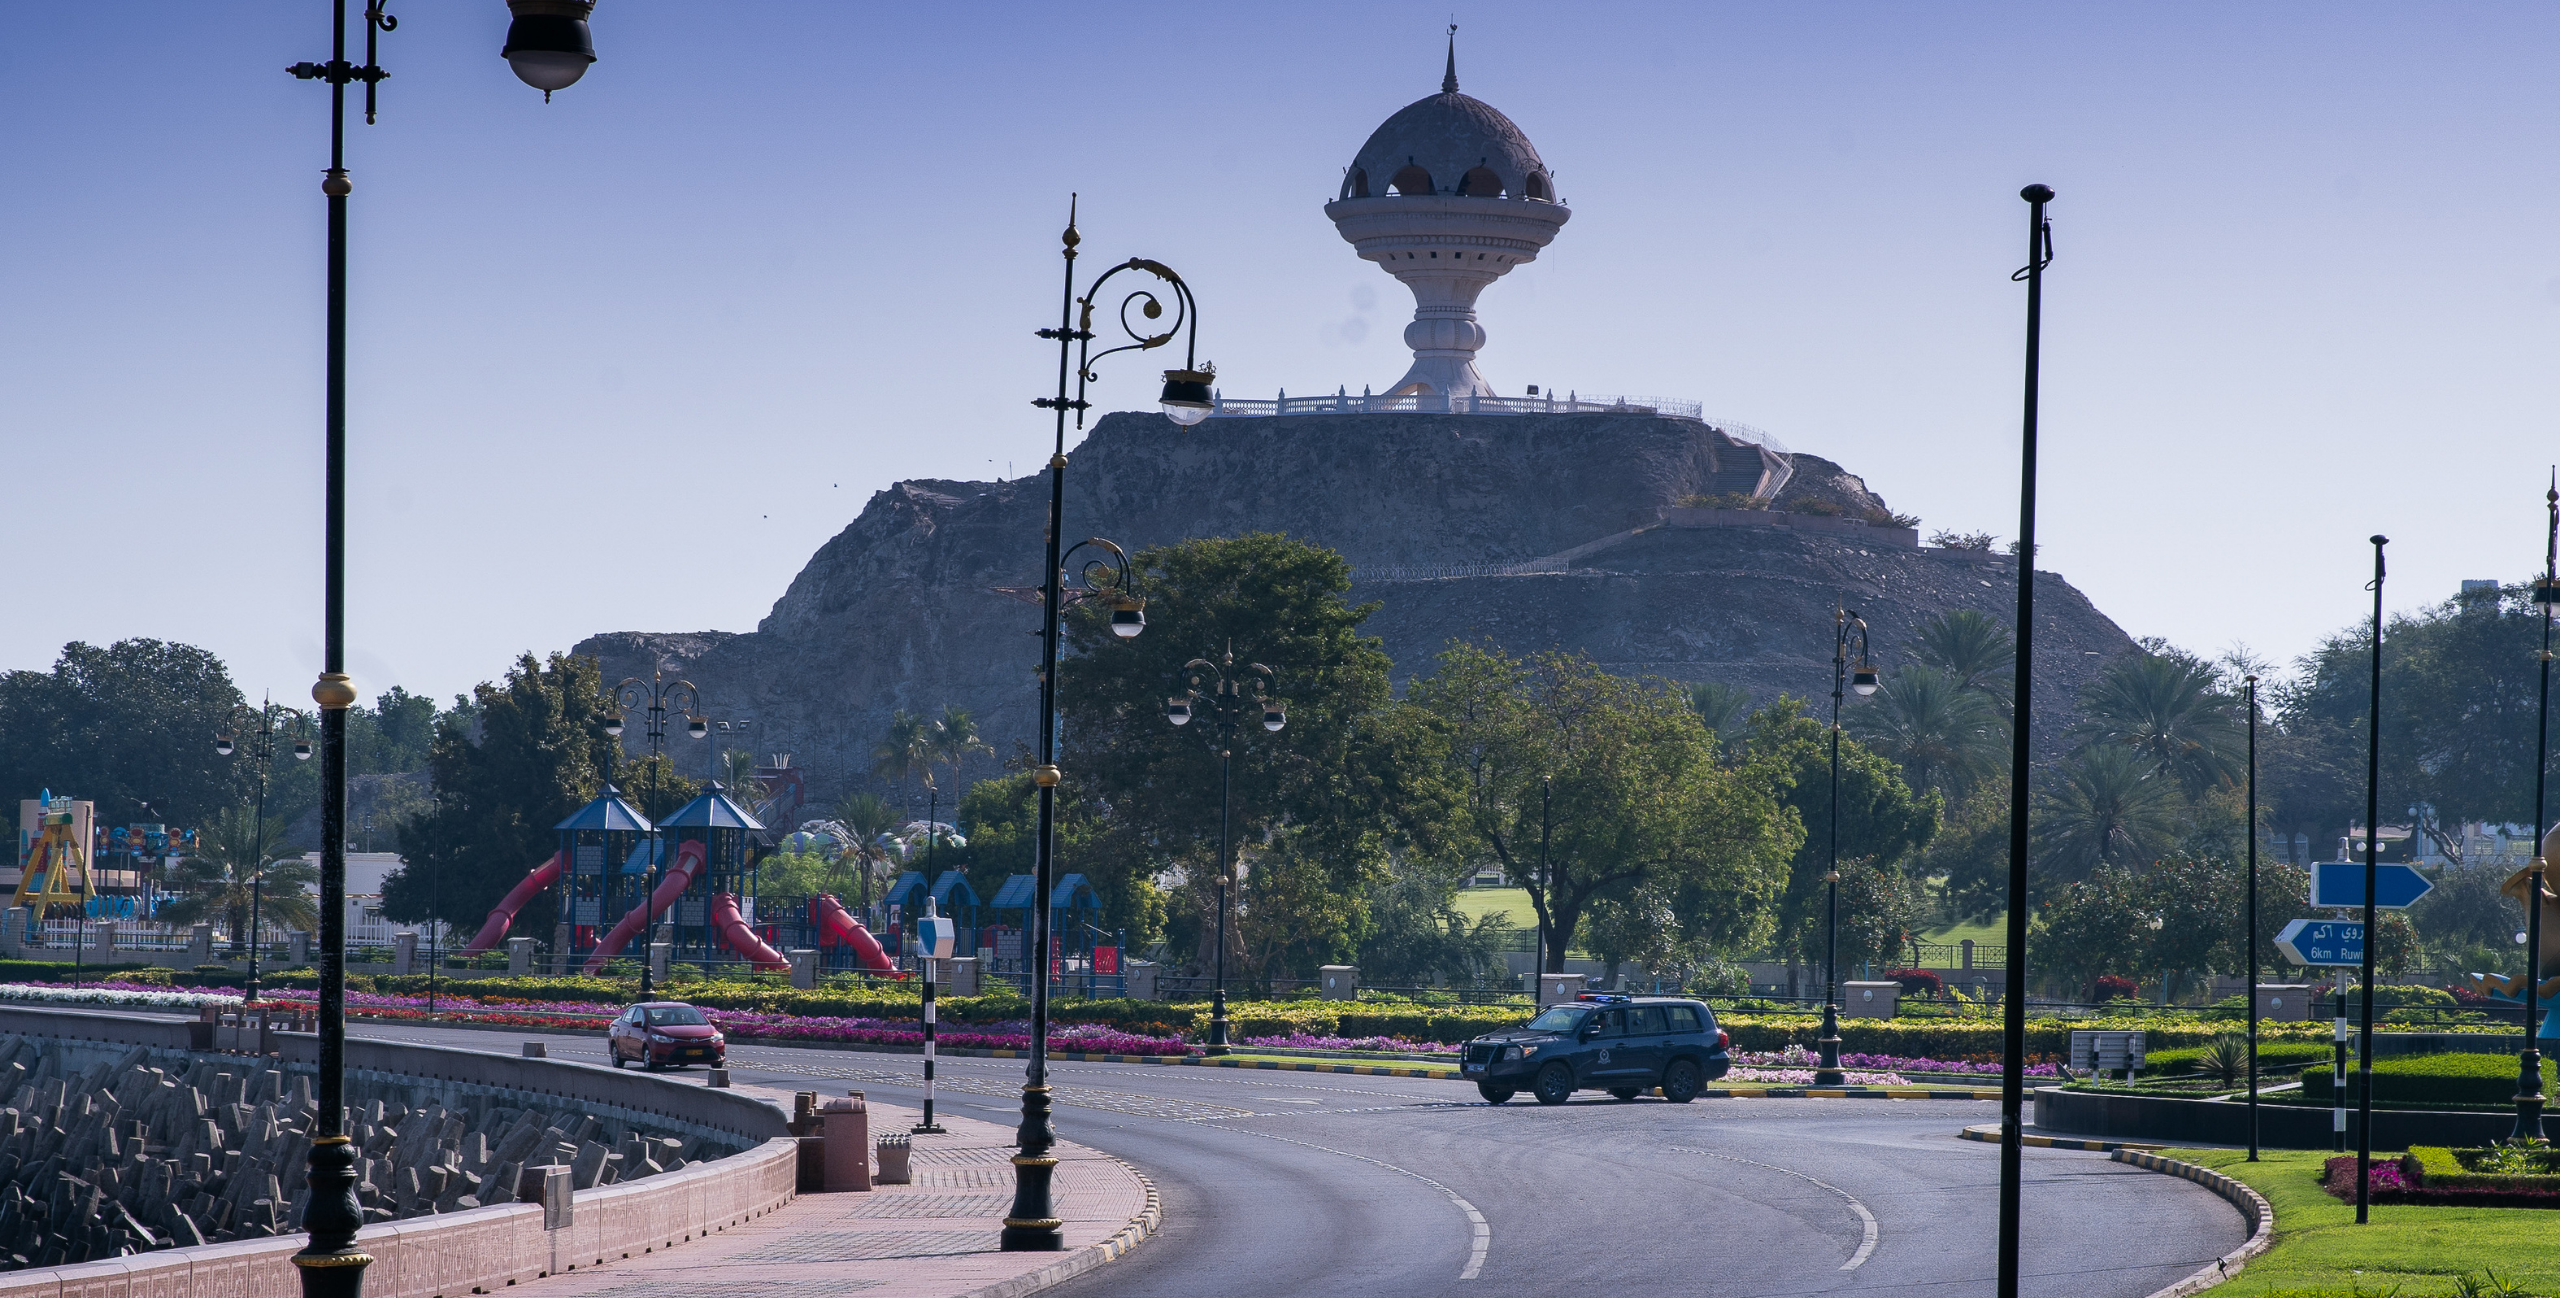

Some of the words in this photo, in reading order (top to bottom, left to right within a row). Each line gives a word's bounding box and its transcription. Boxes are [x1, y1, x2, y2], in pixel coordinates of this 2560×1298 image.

[2341, 927, 2364, 943] روي
[2311, 946, 2332, 959] 6km
[2340, 947, 2364, 960] Ruwi
